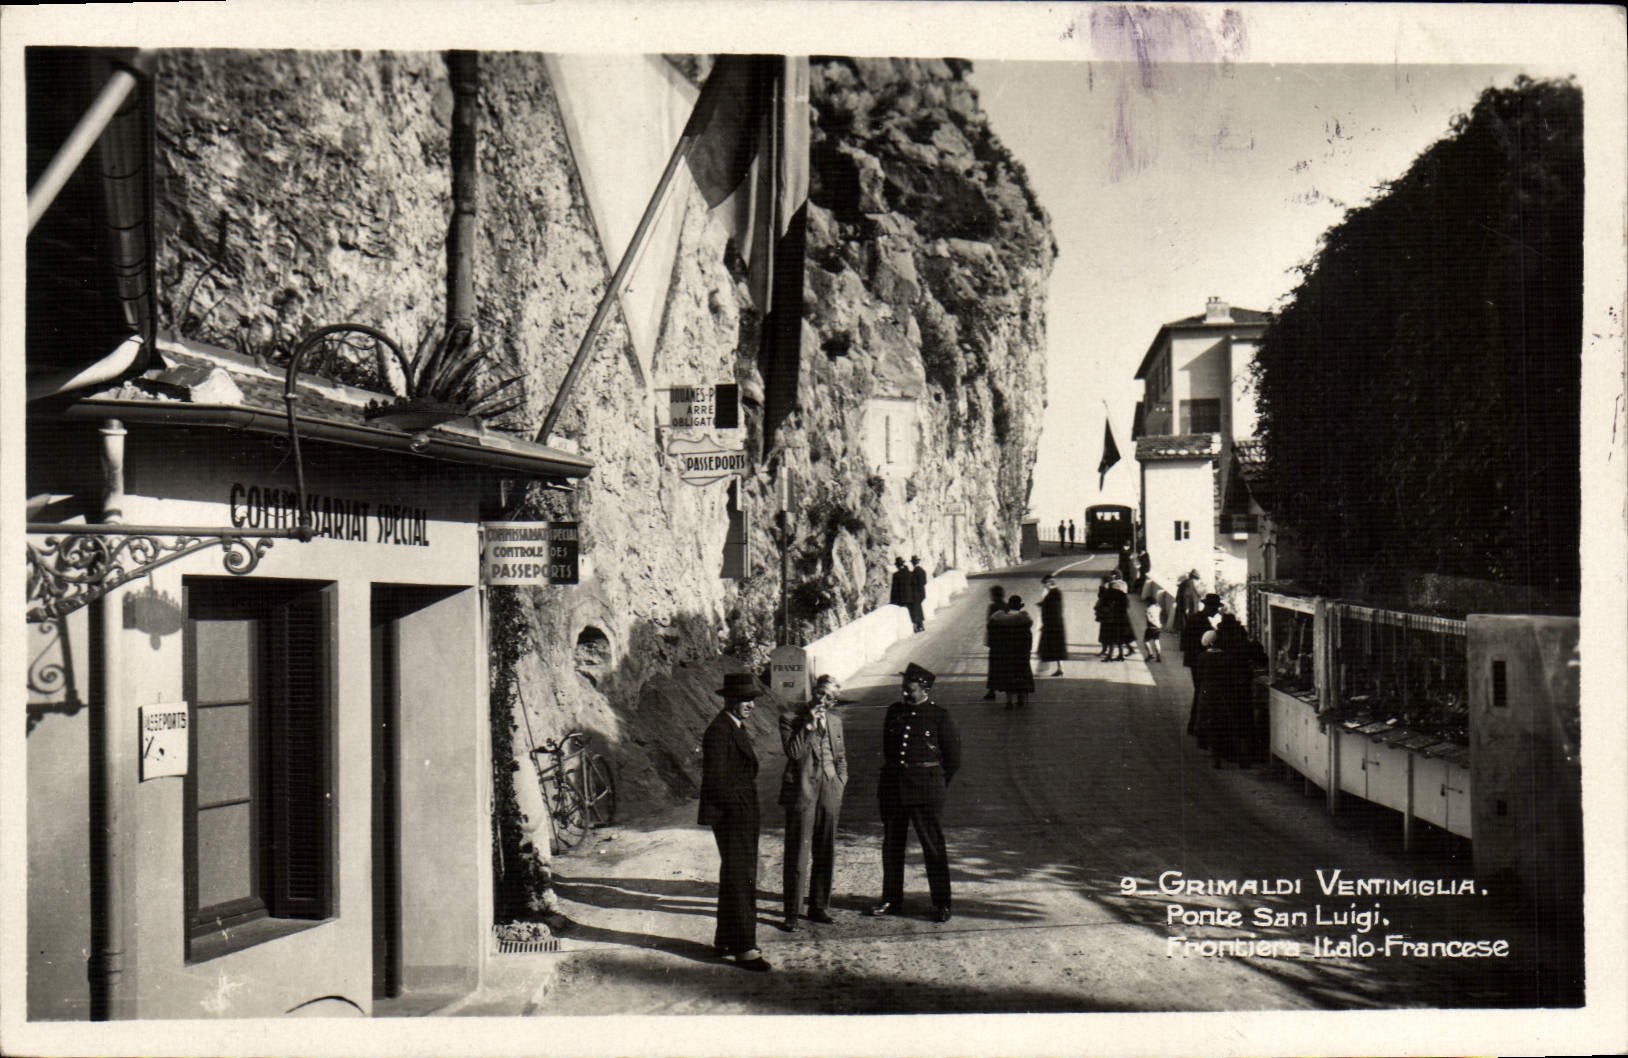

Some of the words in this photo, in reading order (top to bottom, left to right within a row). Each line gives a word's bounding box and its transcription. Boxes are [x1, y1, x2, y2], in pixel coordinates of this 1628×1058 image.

[687, 454, 745, 471] PASSEPORTS
[230, 482, 370, 542] COMMSSARIAT
[376, 503, 430, 547] SPECIAL
[493, 546, 543, 558] CONTROLE
[550, 547, 568, 557] DES
[491, 563, 572, 579] PASSEPORTS
